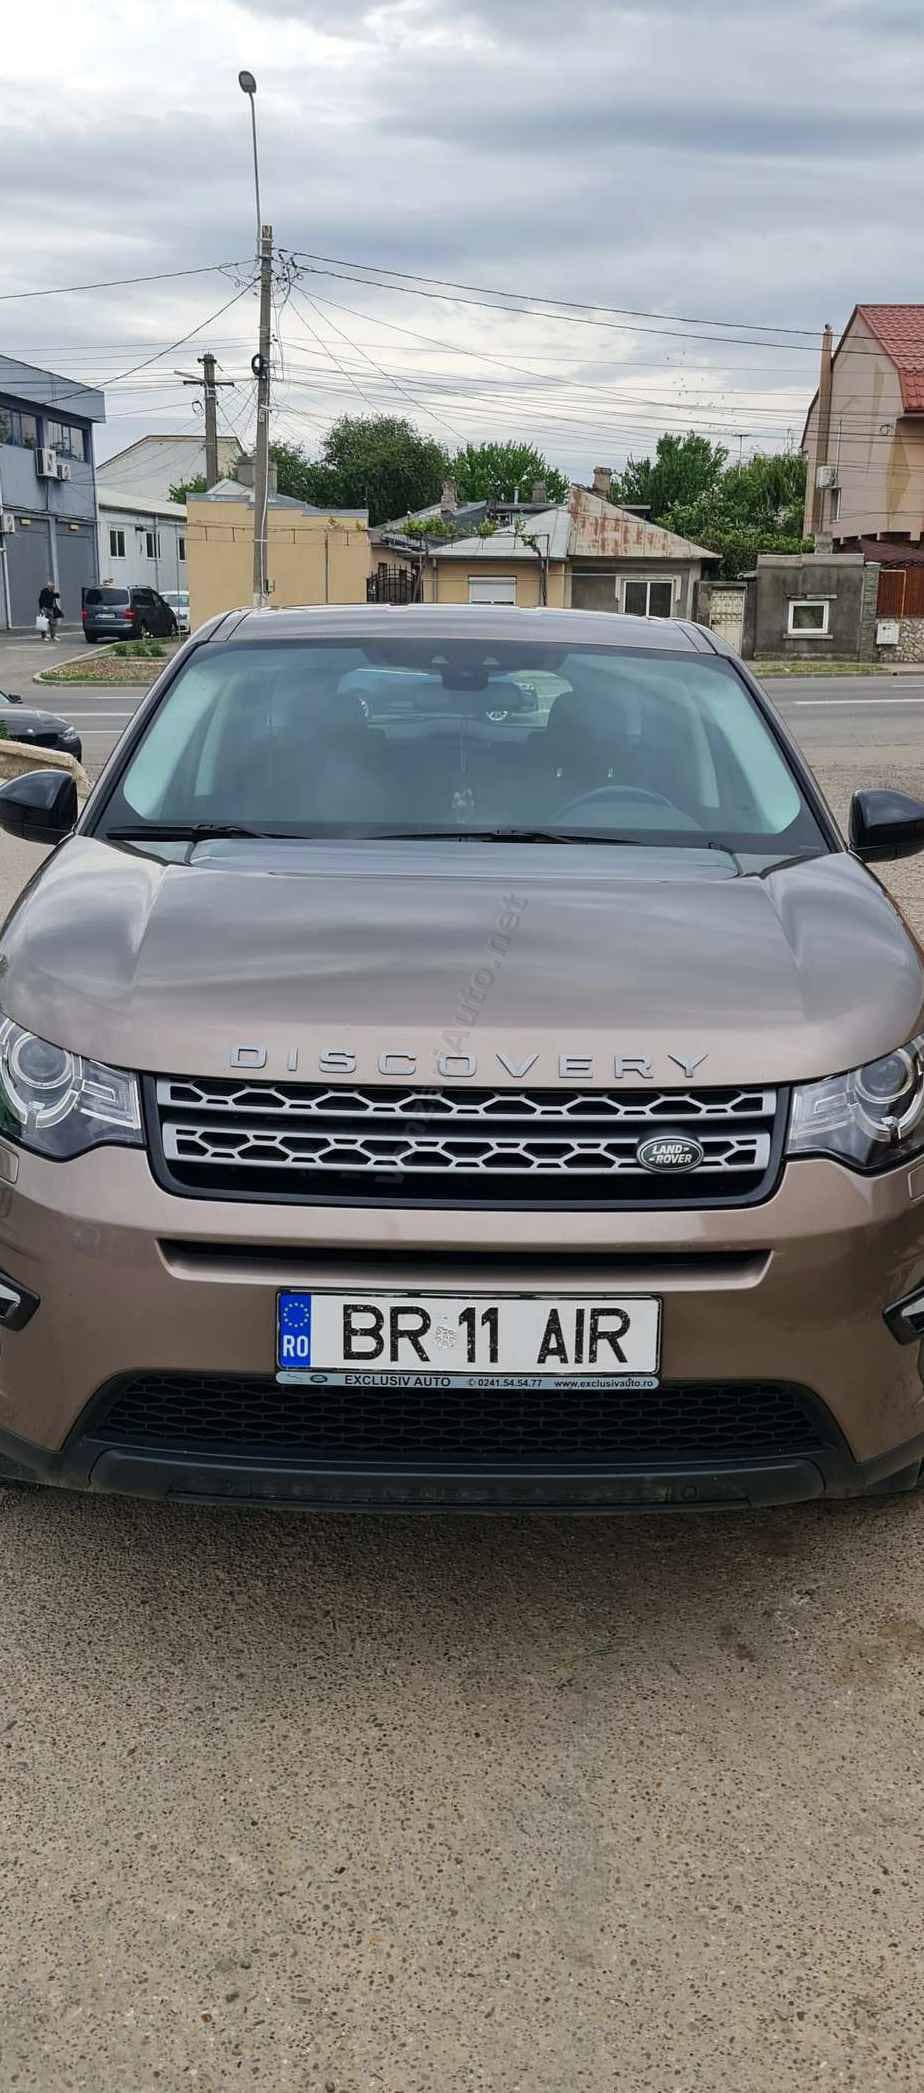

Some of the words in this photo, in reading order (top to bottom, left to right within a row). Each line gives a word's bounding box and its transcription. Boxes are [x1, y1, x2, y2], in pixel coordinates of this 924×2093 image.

[231, 1046, 708, 1079] DISCOVERY
[282, 1335, 308, 1357] RO
[343, 1304, 431, 1362] BR
[459, 1307, 499, 1363] 11
[537, 1308, 631, 1364] AIR
[345, 1375, 410, 1386] EXCLUSIV
[414, 1376, 451, 1387] AUTO
[478, 1378, 543, 1387] 0241.54.54.77
